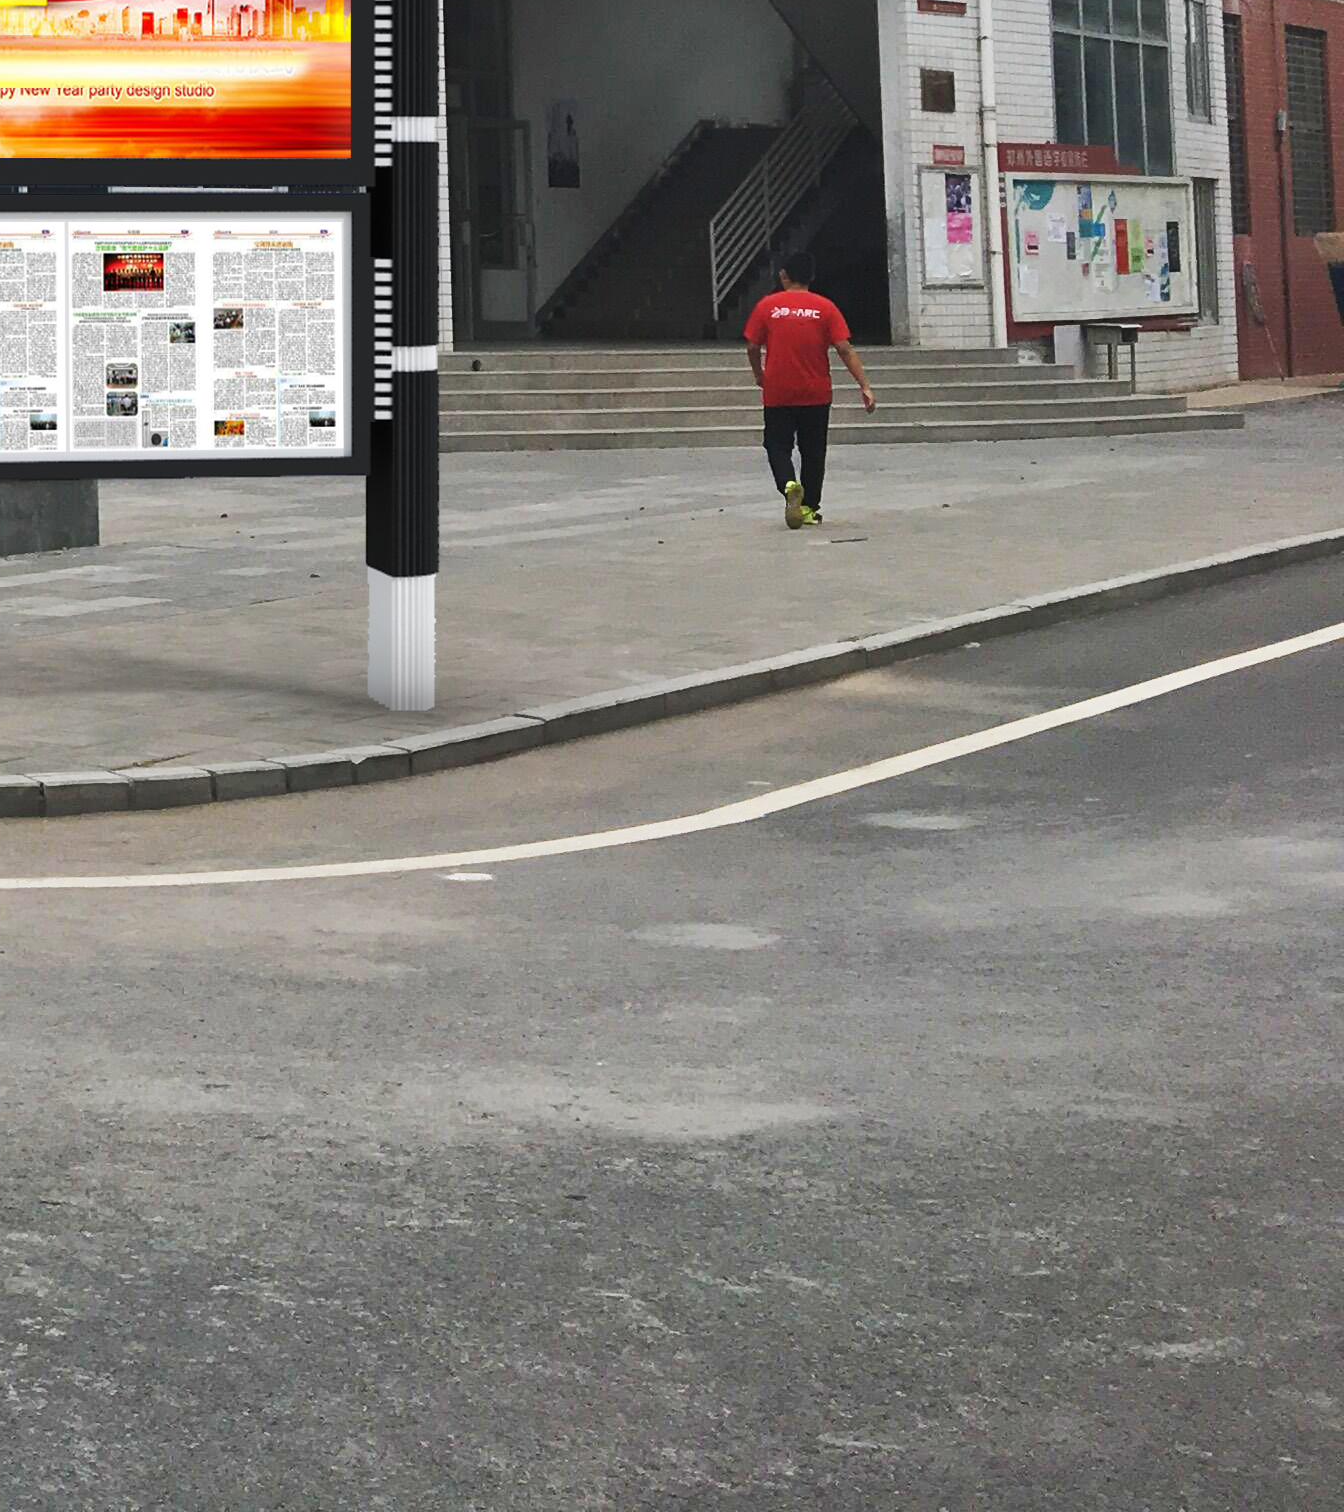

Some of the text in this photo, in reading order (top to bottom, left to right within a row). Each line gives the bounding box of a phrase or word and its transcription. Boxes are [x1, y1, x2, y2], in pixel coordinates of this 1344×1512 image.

[56, 84, 85, 97] Year
[89, 85, 123, 100] party
[126, 83, 171, 101] design
[174, 83, 216, 98] studio
